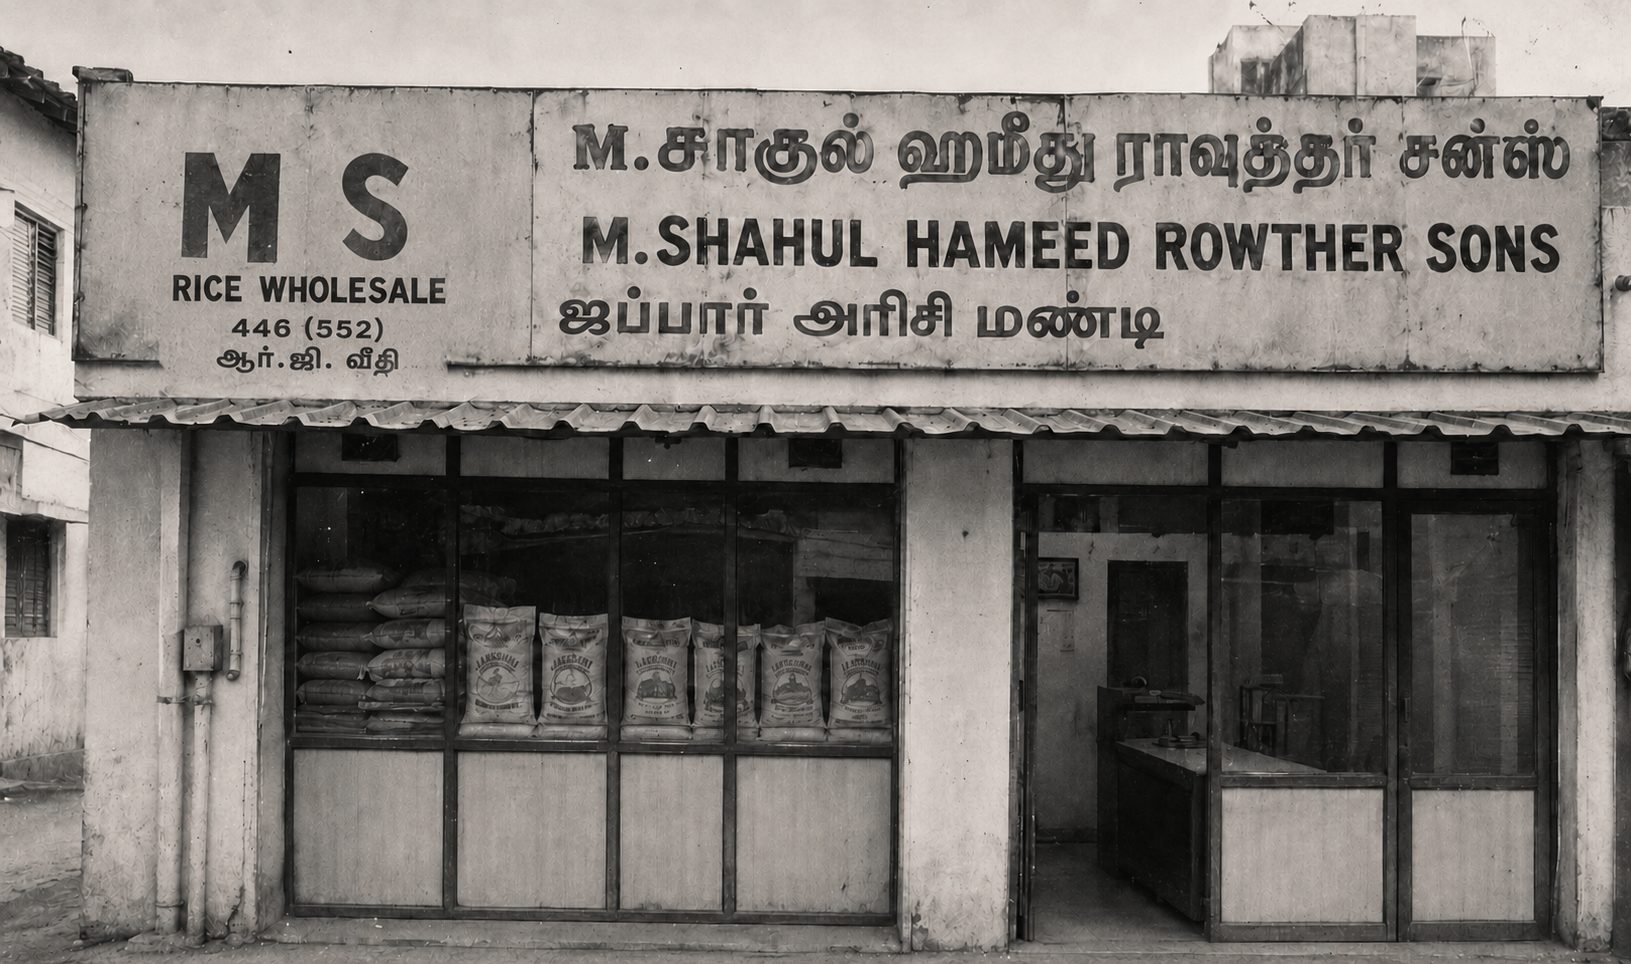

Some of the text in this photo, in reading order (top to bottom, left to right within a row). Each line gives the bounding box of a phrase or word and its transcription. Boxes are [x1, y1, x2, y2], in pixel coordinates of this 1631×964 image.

[897, 111, 1096, 193] ஹமீது
[1113, 117, 1376, 194] ராவுத்தர்
[1399, 118, 1571, 180] சன்ஸ்
[181, 152, 409, 263] M S
[906, 220, 1130, 269] HAMEED
[1155, 222, 1404, 272] ROWTHER
[1426, 223, 1560, 273] SONS
[172, 274, 446, 304] RICE WHOLESALE
[231, 315, 384, 343] 446 (552)
[558, 286, 1165, 349] ஜப்பார் அரிசி மண்டி
[346, 346, 399, 377] வீதி
